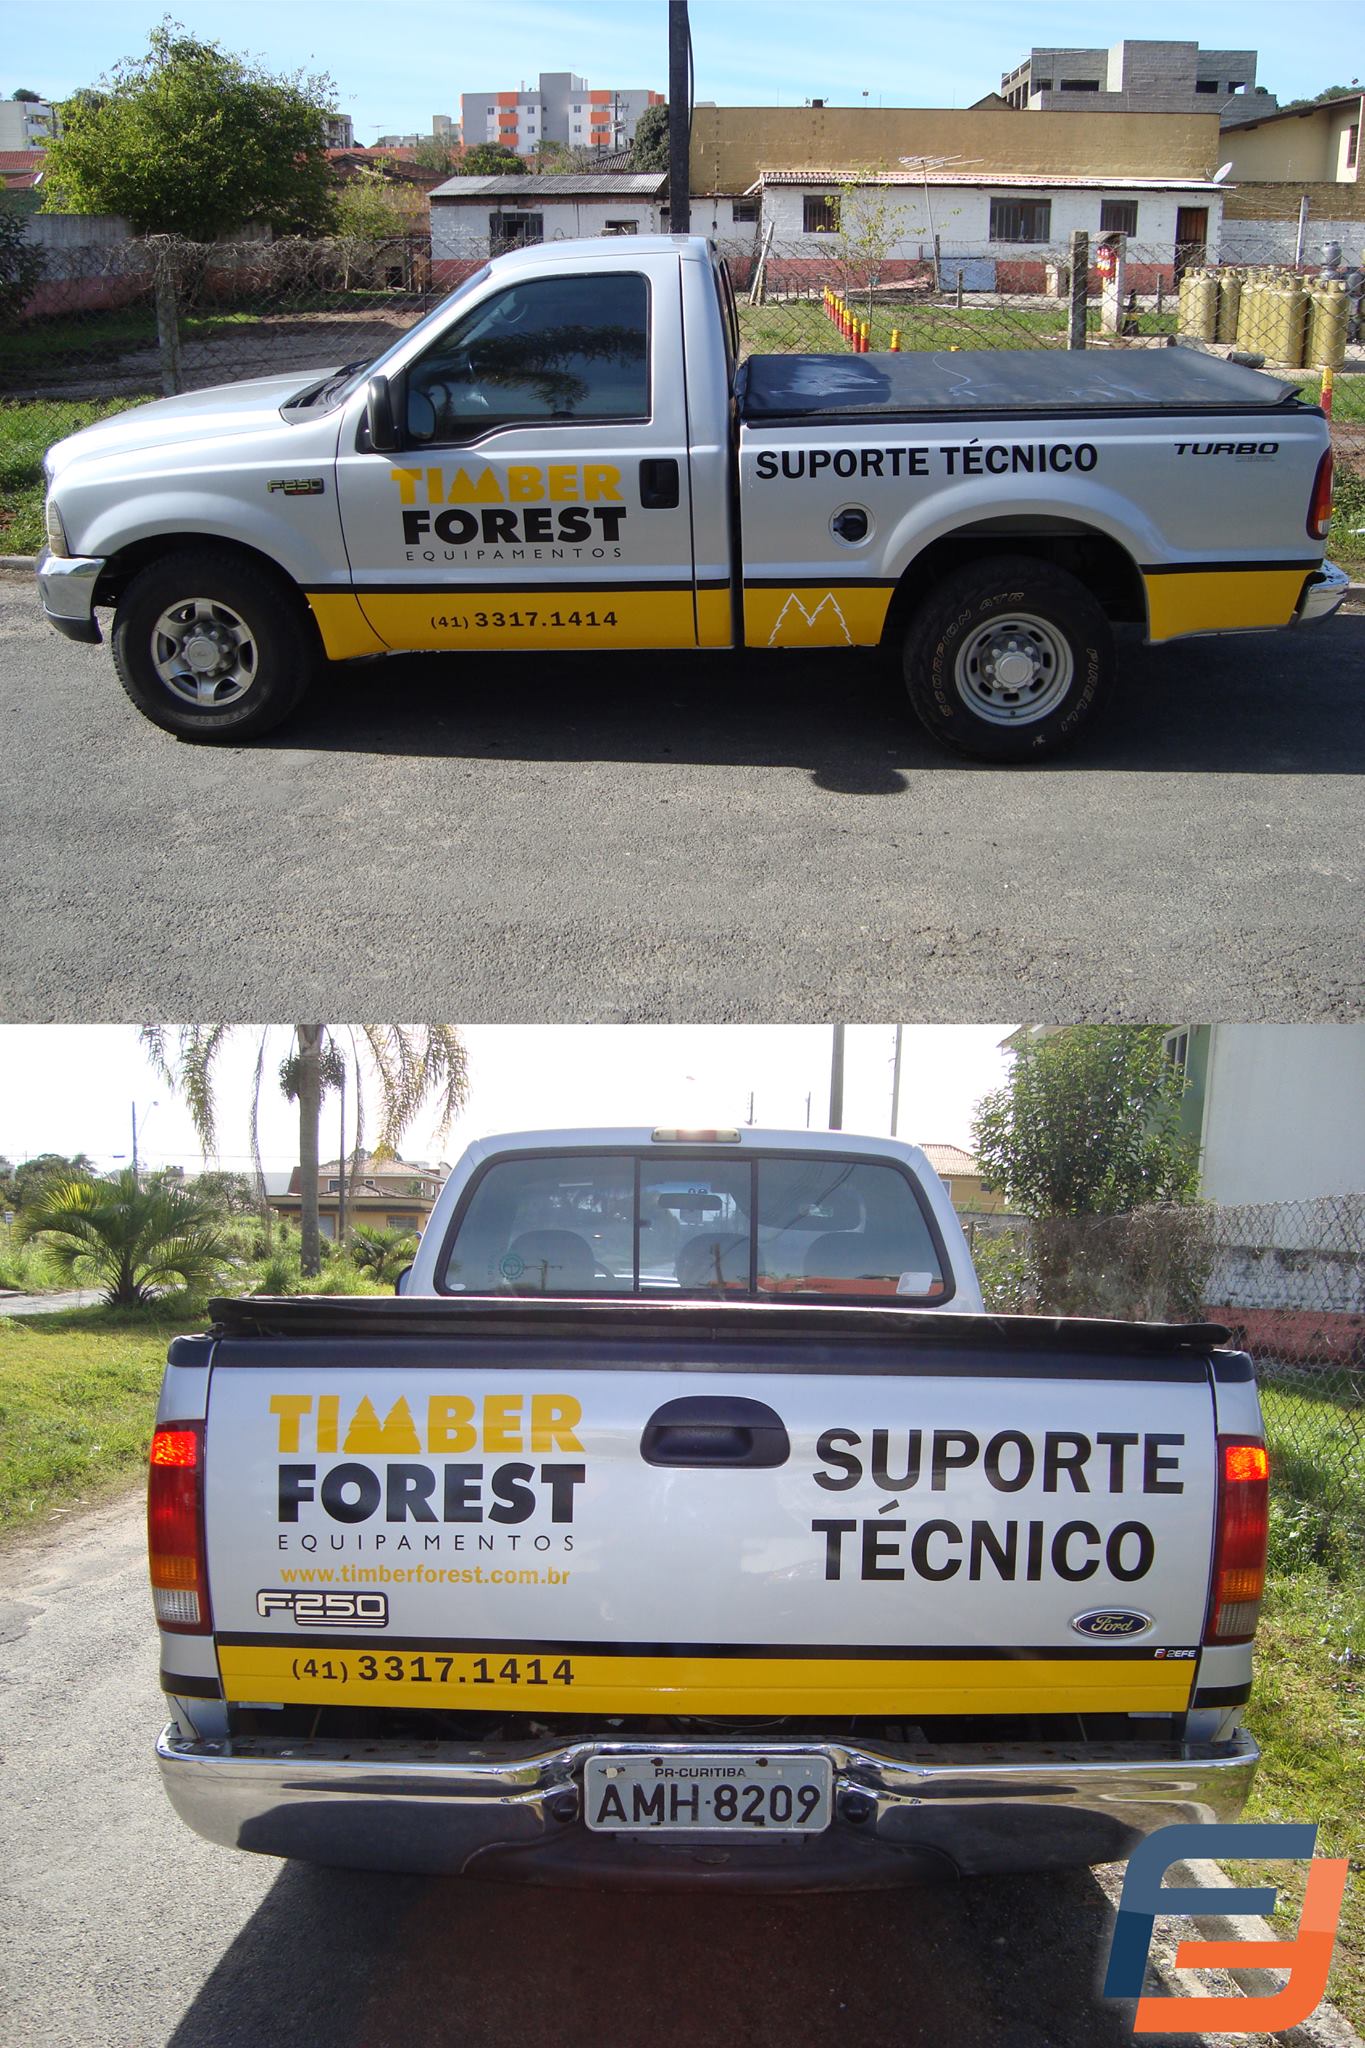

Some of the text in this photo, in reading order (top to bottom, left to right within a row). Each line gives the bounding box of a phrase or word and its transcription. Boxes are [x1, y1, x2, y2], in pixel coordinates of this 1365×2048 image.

[755, 438, 1099, 480] SUPORTE TÉCNICO
[1174, 442, 1280, 455] TURBO
[390, 464, 624, 505] TIMBER
[401, 506, 627, 545] FOREST
[405, 548, 622, 561] EQUIPAMENTOS
[430, 610, 619, 630] (41) 3317.1414
[931, 609, 972, 717] SCORPION
[1052, 648, 1099, 732] PIRELLI
[269, 1394, 586, 1454] TIMBER
[812, 1427, 1186, 1495] SUPORTE
[278, 1462, 586, 1524] FOREST
[279, 1534, 574, 1553] EQUIPAMENTOS
[811, 1499, 1156, 1583] TÉCNICO
[280, 1564, 571, 1585] www.timberforest.com.br
[257, 1591, 387, 1618] F-250
[1091, 1615, 1134, 1631] Ford
[292, 1655, 575, 1686] (41) 3317.1414
